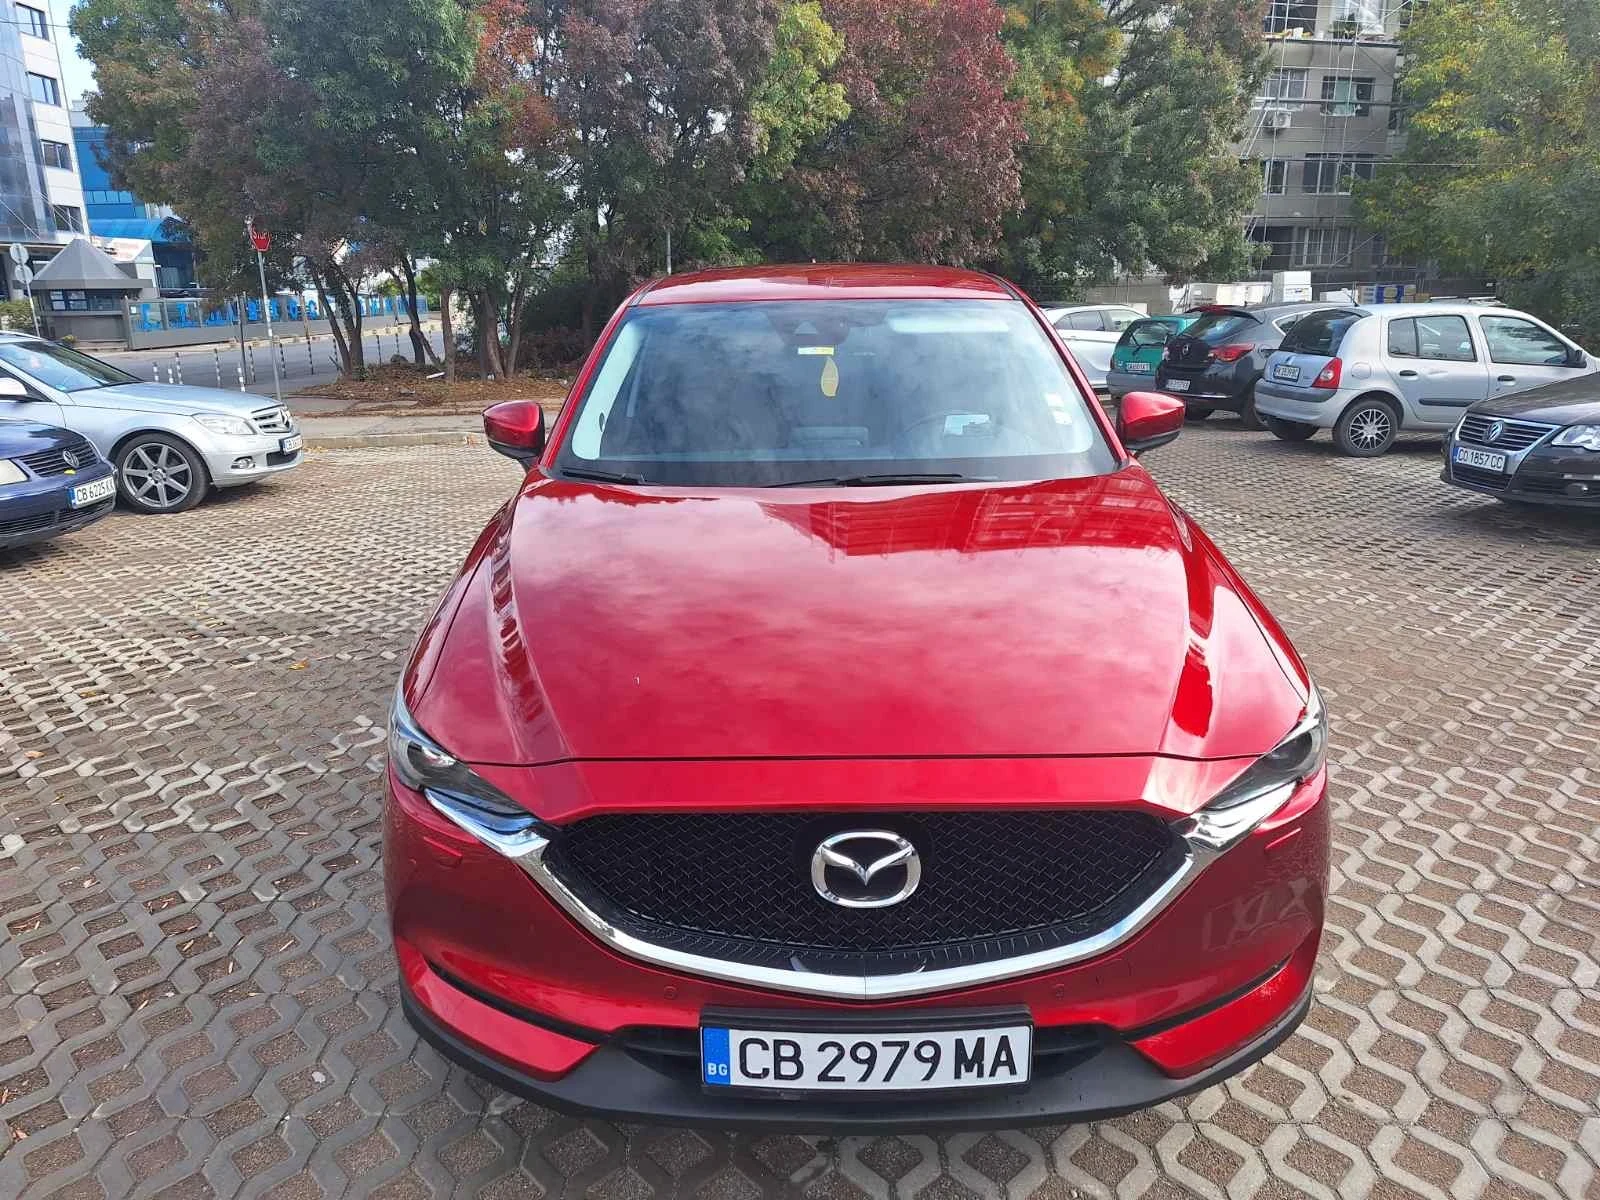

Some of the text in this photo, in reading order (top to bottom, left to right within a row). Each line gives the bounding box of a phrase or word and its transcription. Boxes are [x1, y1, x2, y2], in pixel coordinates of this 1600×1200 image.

[1471, 451, 1490, 466] 1857
[76, 487, 88, 502] CB
[89, 482, 106, 499] 6225
[738, 1035, 1018, 1083] CB 2979 MA
[707, 1062, 728, 1076] BG
